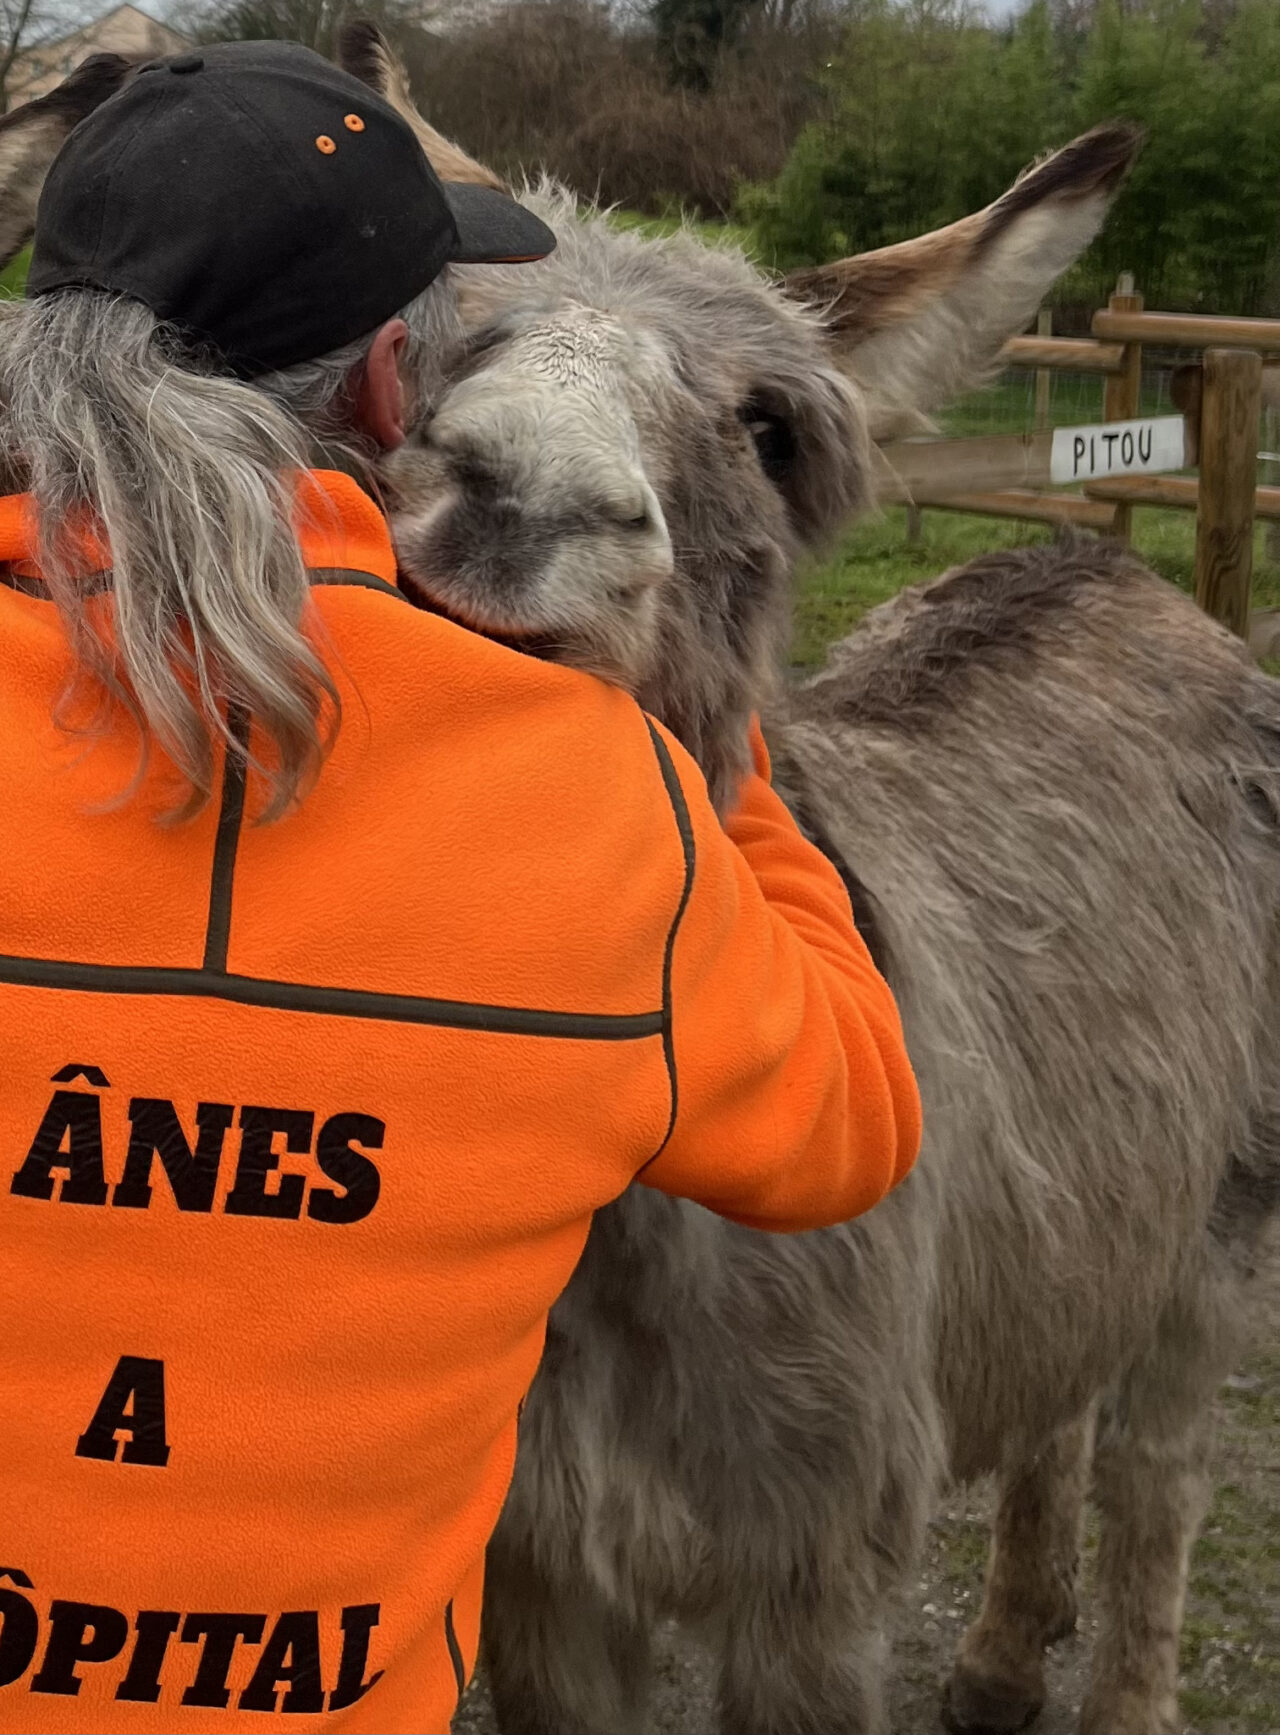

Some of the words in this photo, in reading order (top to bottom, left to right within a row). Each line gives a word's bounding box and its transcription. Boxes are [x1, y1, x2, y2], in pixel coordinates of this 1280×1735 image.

[1073, 426, 1153, 477] PITOU
[9, 1063, 387, 1225] ÂNES
[74, 1355, 171, 1467] A
